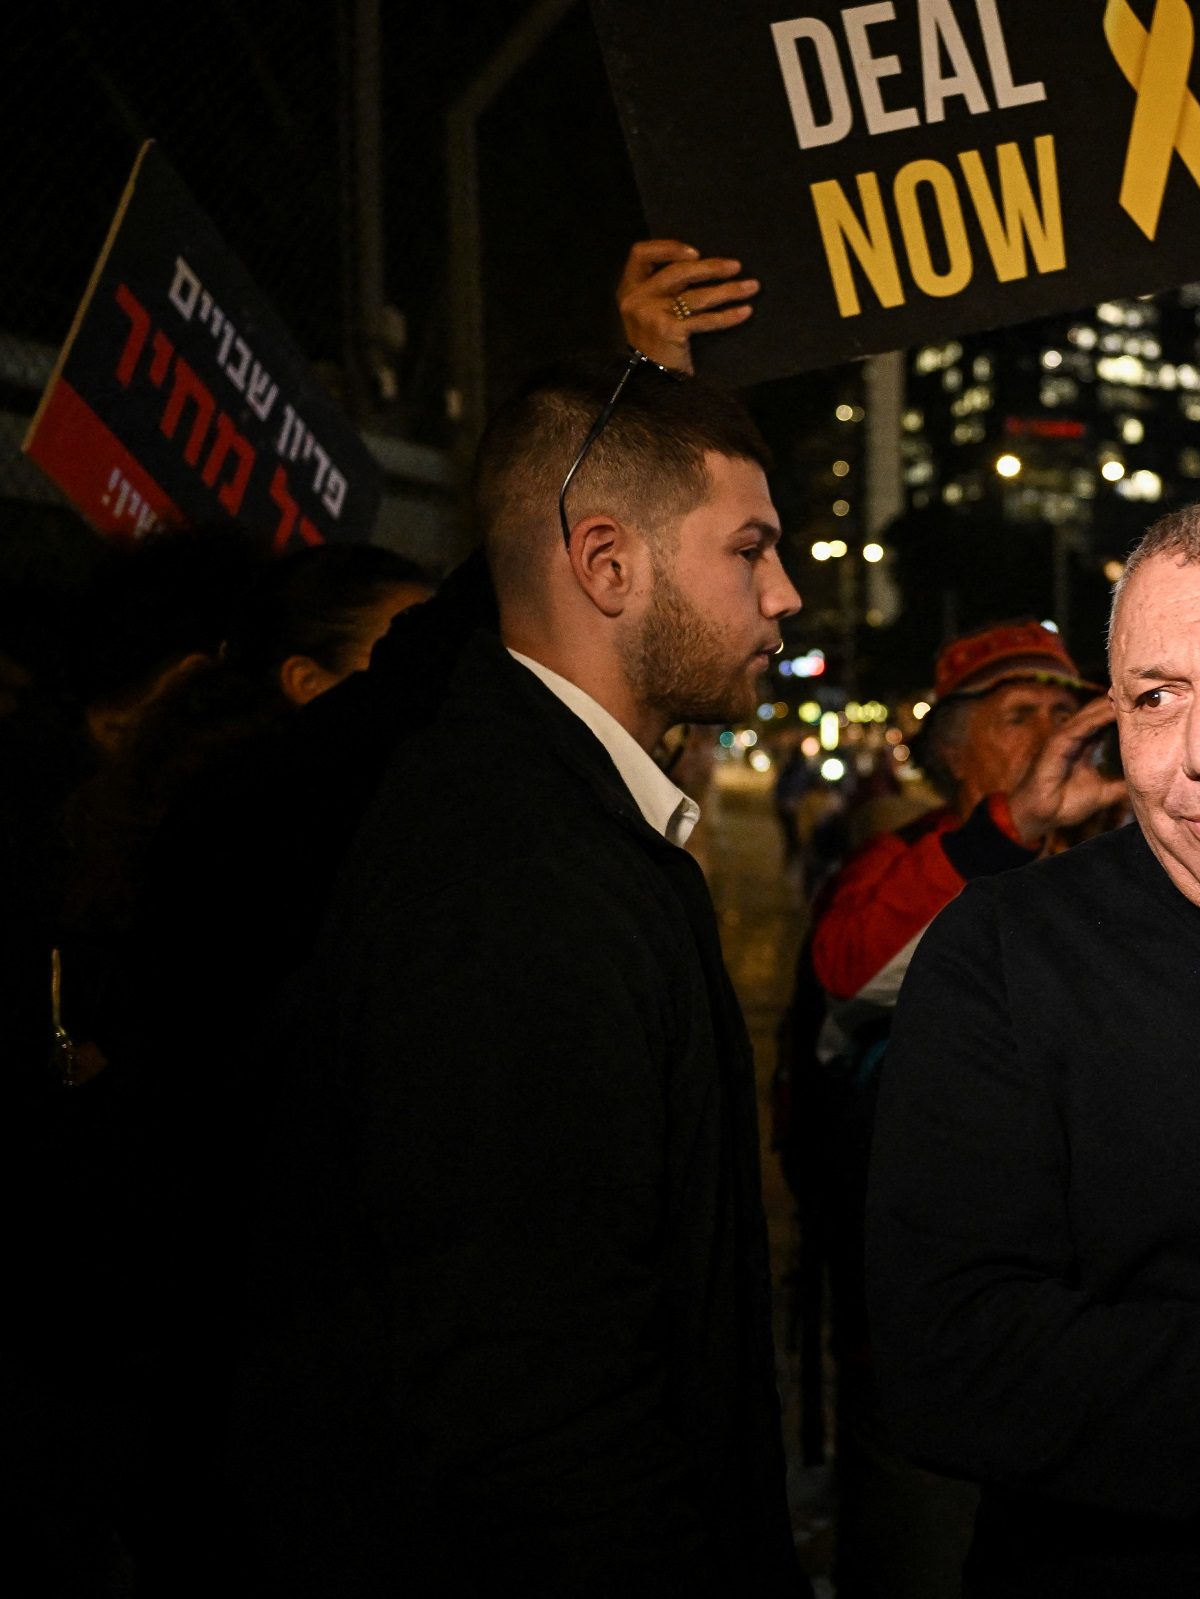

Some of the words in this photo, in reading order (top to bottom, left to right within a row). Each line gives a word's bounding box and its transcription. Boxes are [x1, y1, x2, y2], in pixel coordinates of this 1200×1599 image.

[769, 0, 1046, 149] DEAL
[810, 134, 1066, 318] NOW
[115, 282, 257, 518] מחיר
[168, 256, 279, 421] שבויים
[277, 403, 349, 520] פדיון
